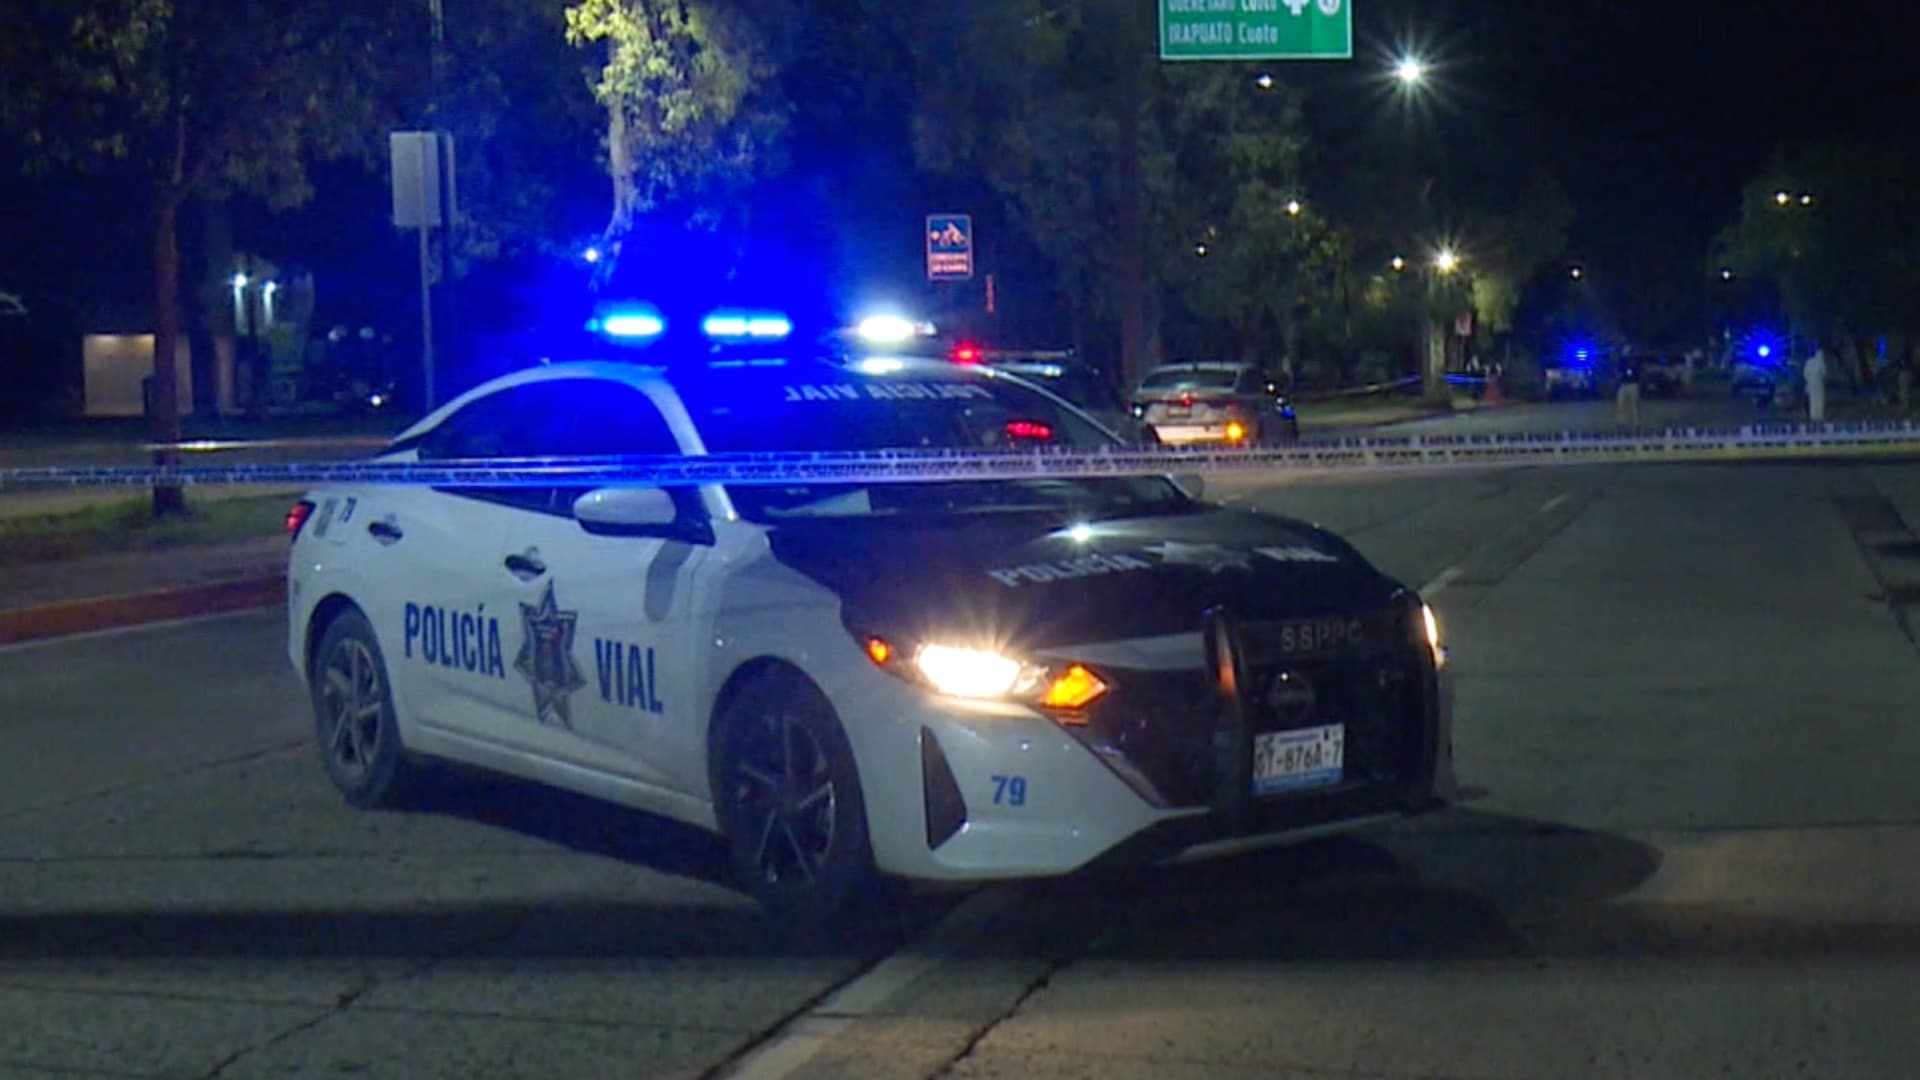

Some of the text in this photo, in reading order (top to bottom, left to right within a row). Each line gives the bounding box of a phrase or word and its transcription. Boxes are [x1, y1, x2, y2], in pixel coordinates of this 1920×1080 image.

[1168, 21, 1278, 44] IRAPUATO Cuota
[404, 601, 664, 714] POLICÍA VIAL
[991, 775, 1027, 807] 79
